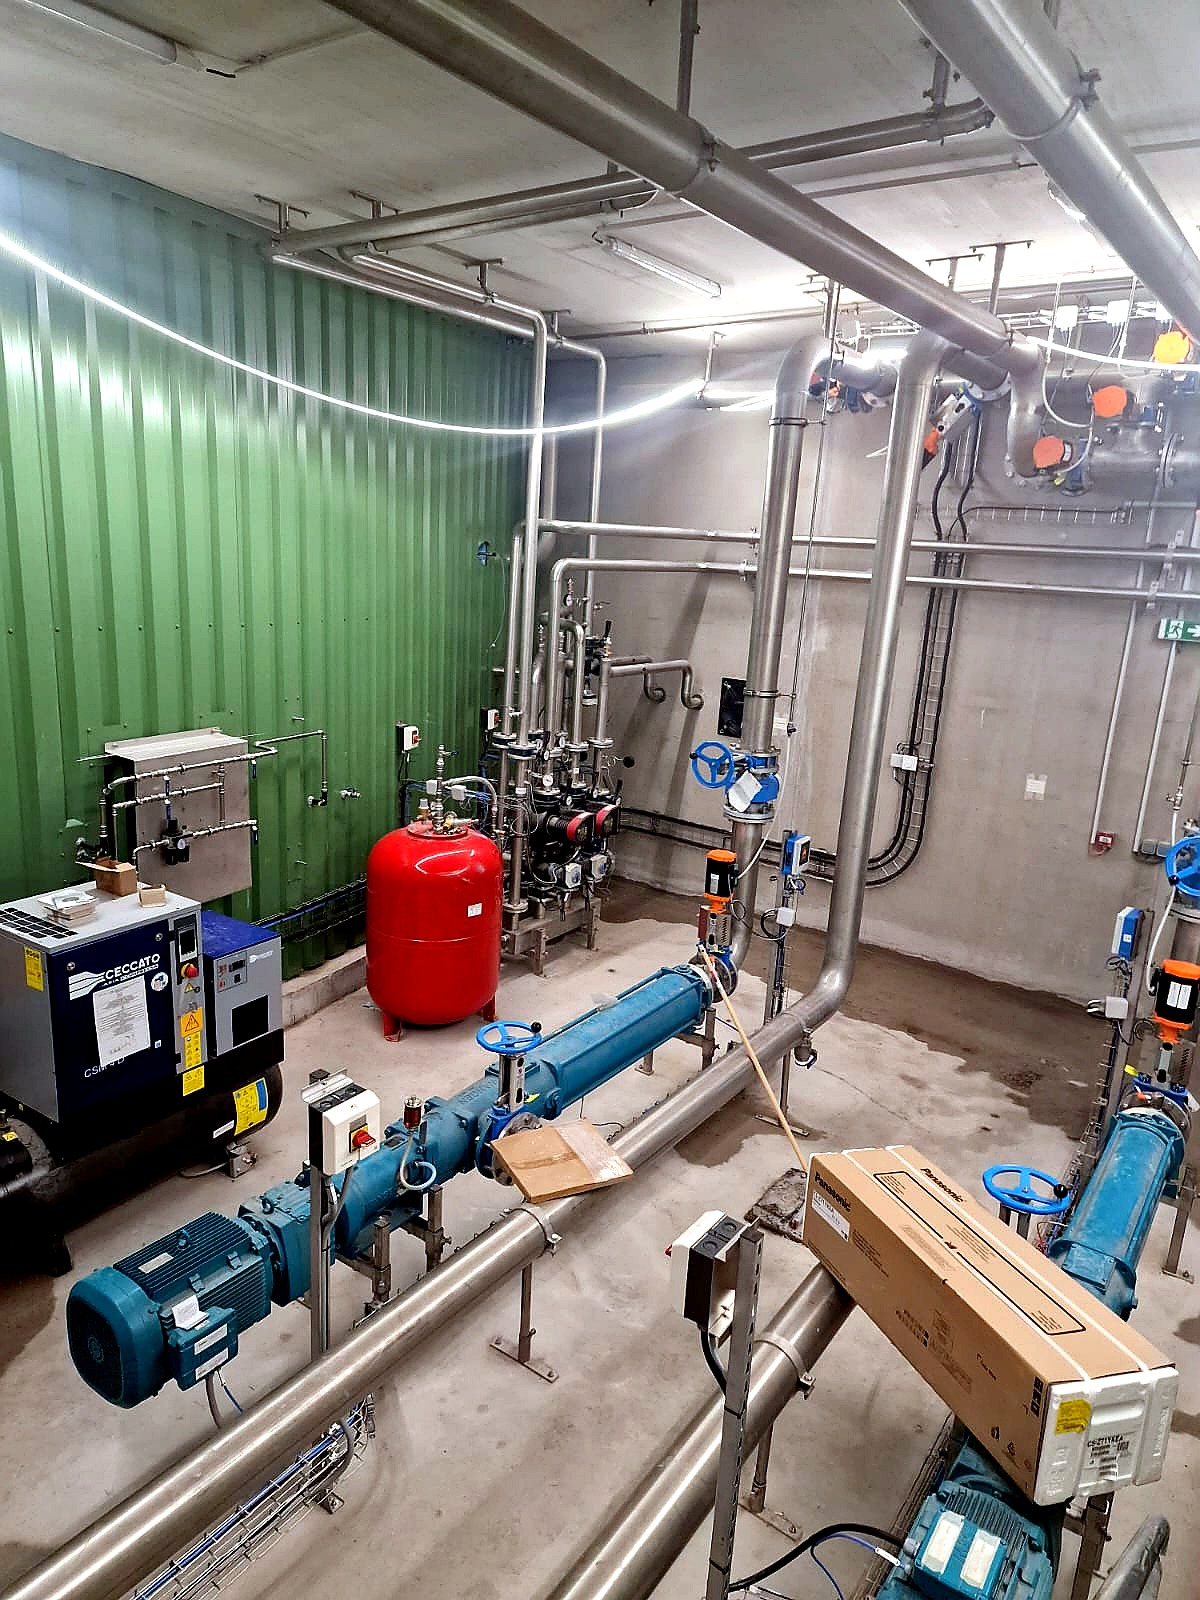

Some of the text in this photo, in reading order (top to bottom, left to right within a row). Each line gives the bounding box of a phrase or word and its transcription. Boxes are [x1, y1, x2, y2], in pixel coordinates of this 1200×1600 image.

[105, 954, 160, 980] CECCATO
[815, 1171, 851, 1212] Panasonic
[920, 1167, 963, 1203] Panasonic
